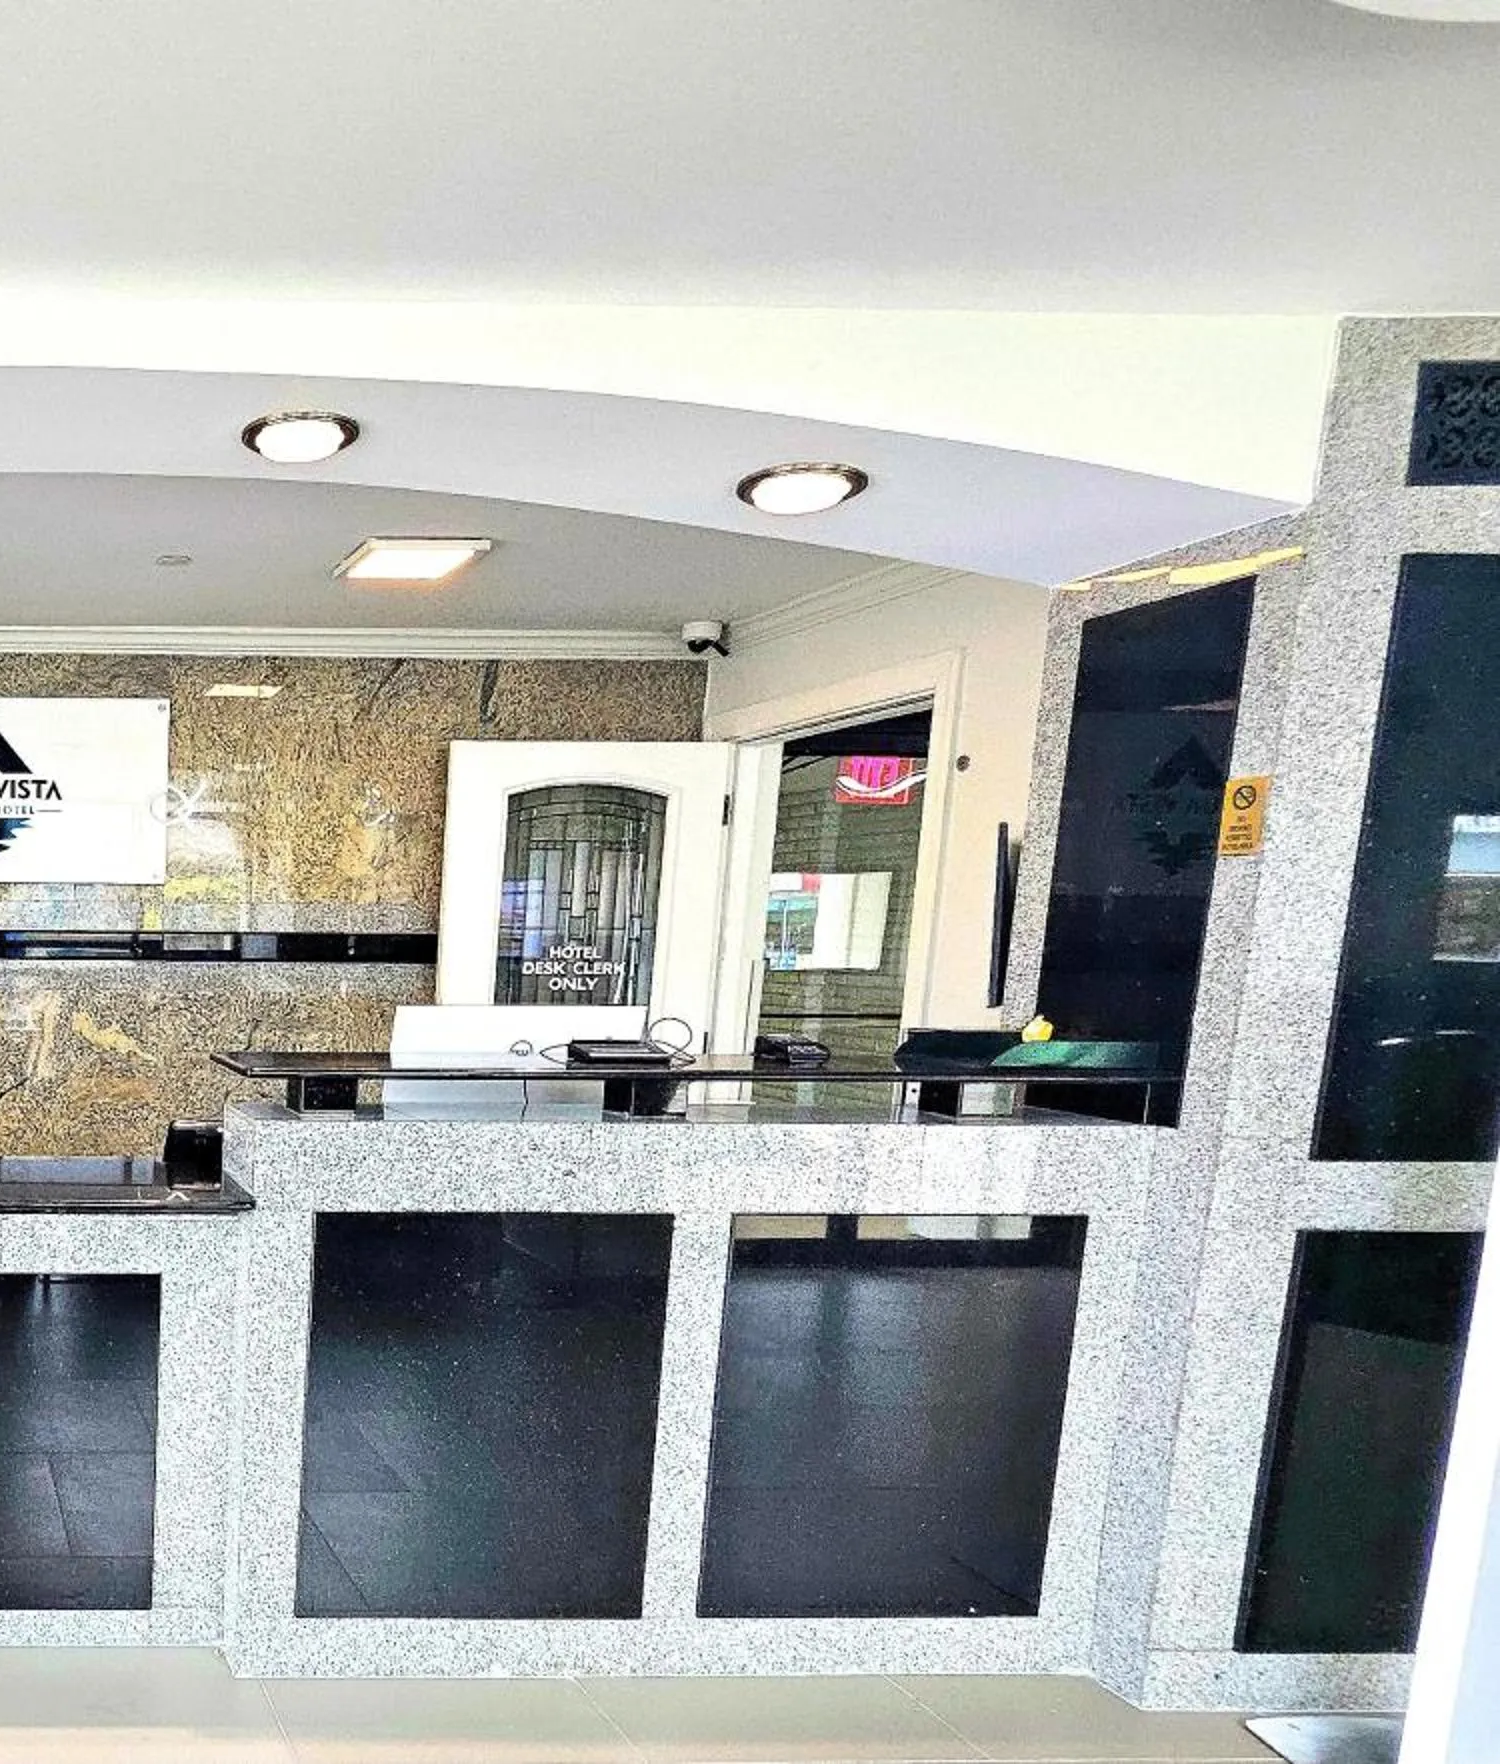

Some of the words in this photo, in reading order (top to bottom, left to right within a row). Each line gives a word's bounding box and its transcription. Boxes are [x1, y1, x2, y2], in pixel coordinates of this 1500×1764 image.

[549, 945, 602, 959] HOTEL
[521, 961, 567, 975] DESK
[573, 961, 626, 975] CLERK
[548, 977, 599, 991] ONLY
